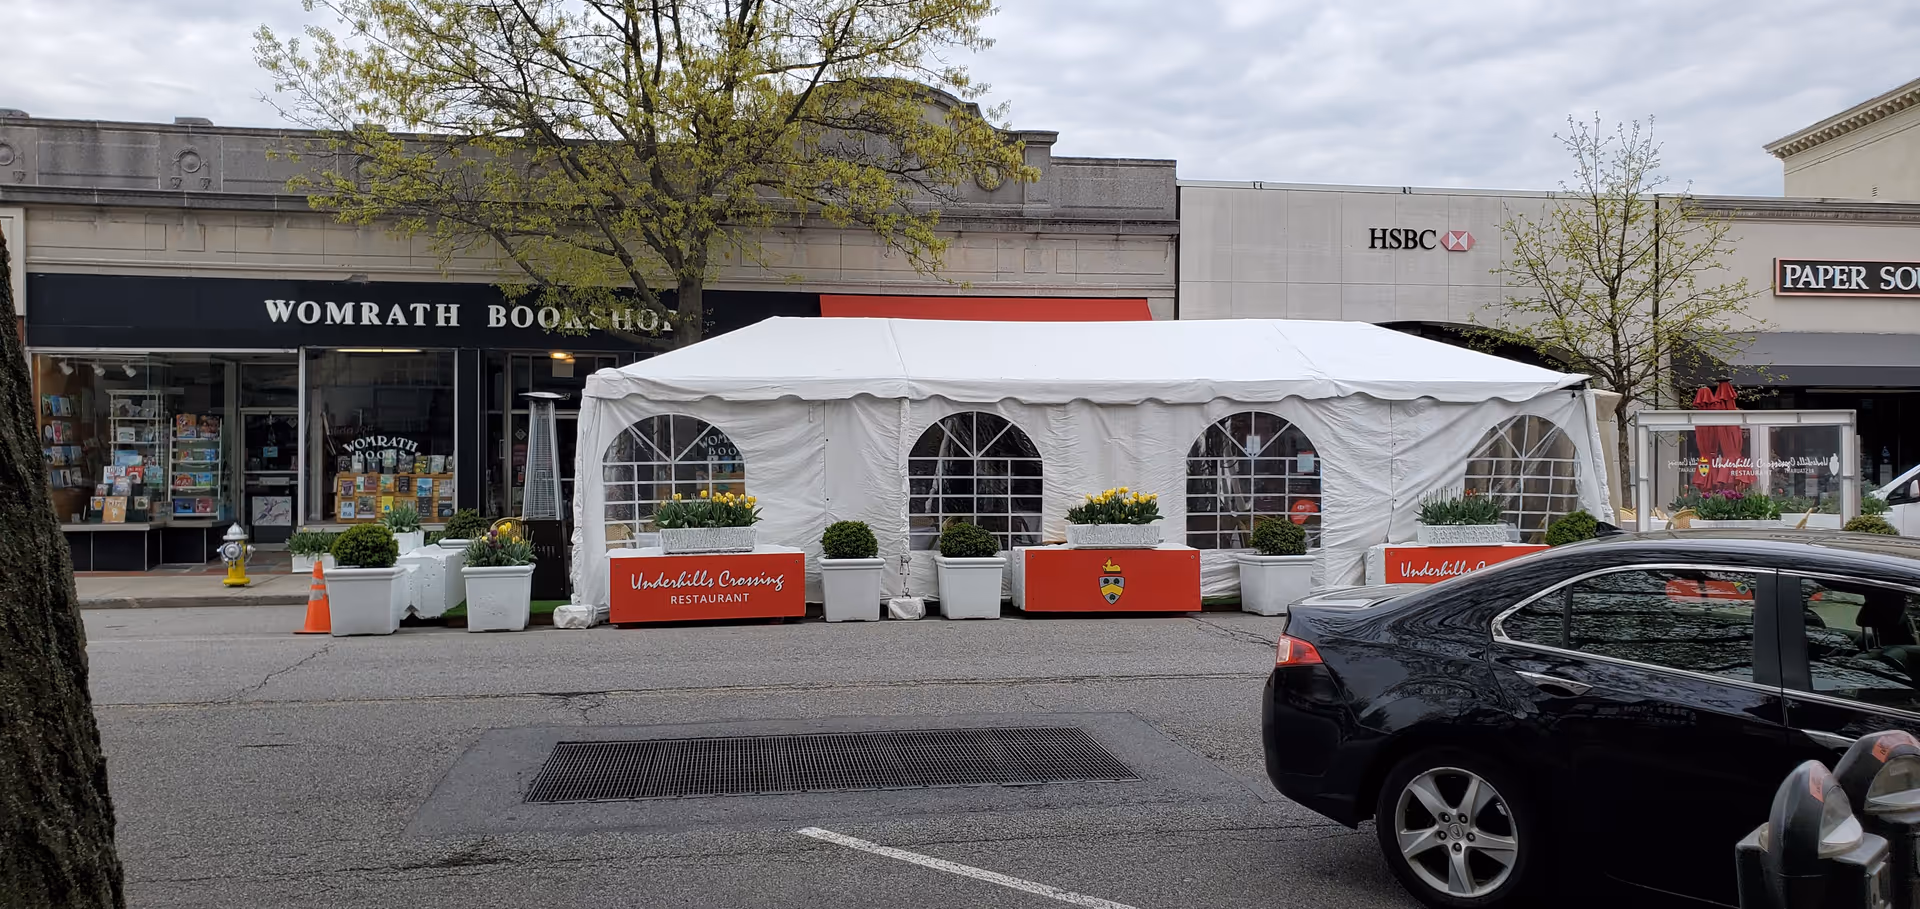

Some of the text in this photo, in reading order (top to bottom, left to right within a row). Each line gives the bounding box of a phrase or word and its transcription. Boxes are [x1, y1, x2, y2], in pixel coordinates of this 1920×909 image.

[1368, 228, 1437, 250] HSBC
[1783, 264, 1920, 291] PAPER SO
[264, 299, 461, 327] WOMRATH
[342, 435, 419, 453] WOMRATH
[355, 449, 407, 460] BOOKS
[1711, 455, 1753, 468] Underhills
[630, 569, 785, 591] Underhills Crossing
[670, 592, 750, 605] RESTAURANT
